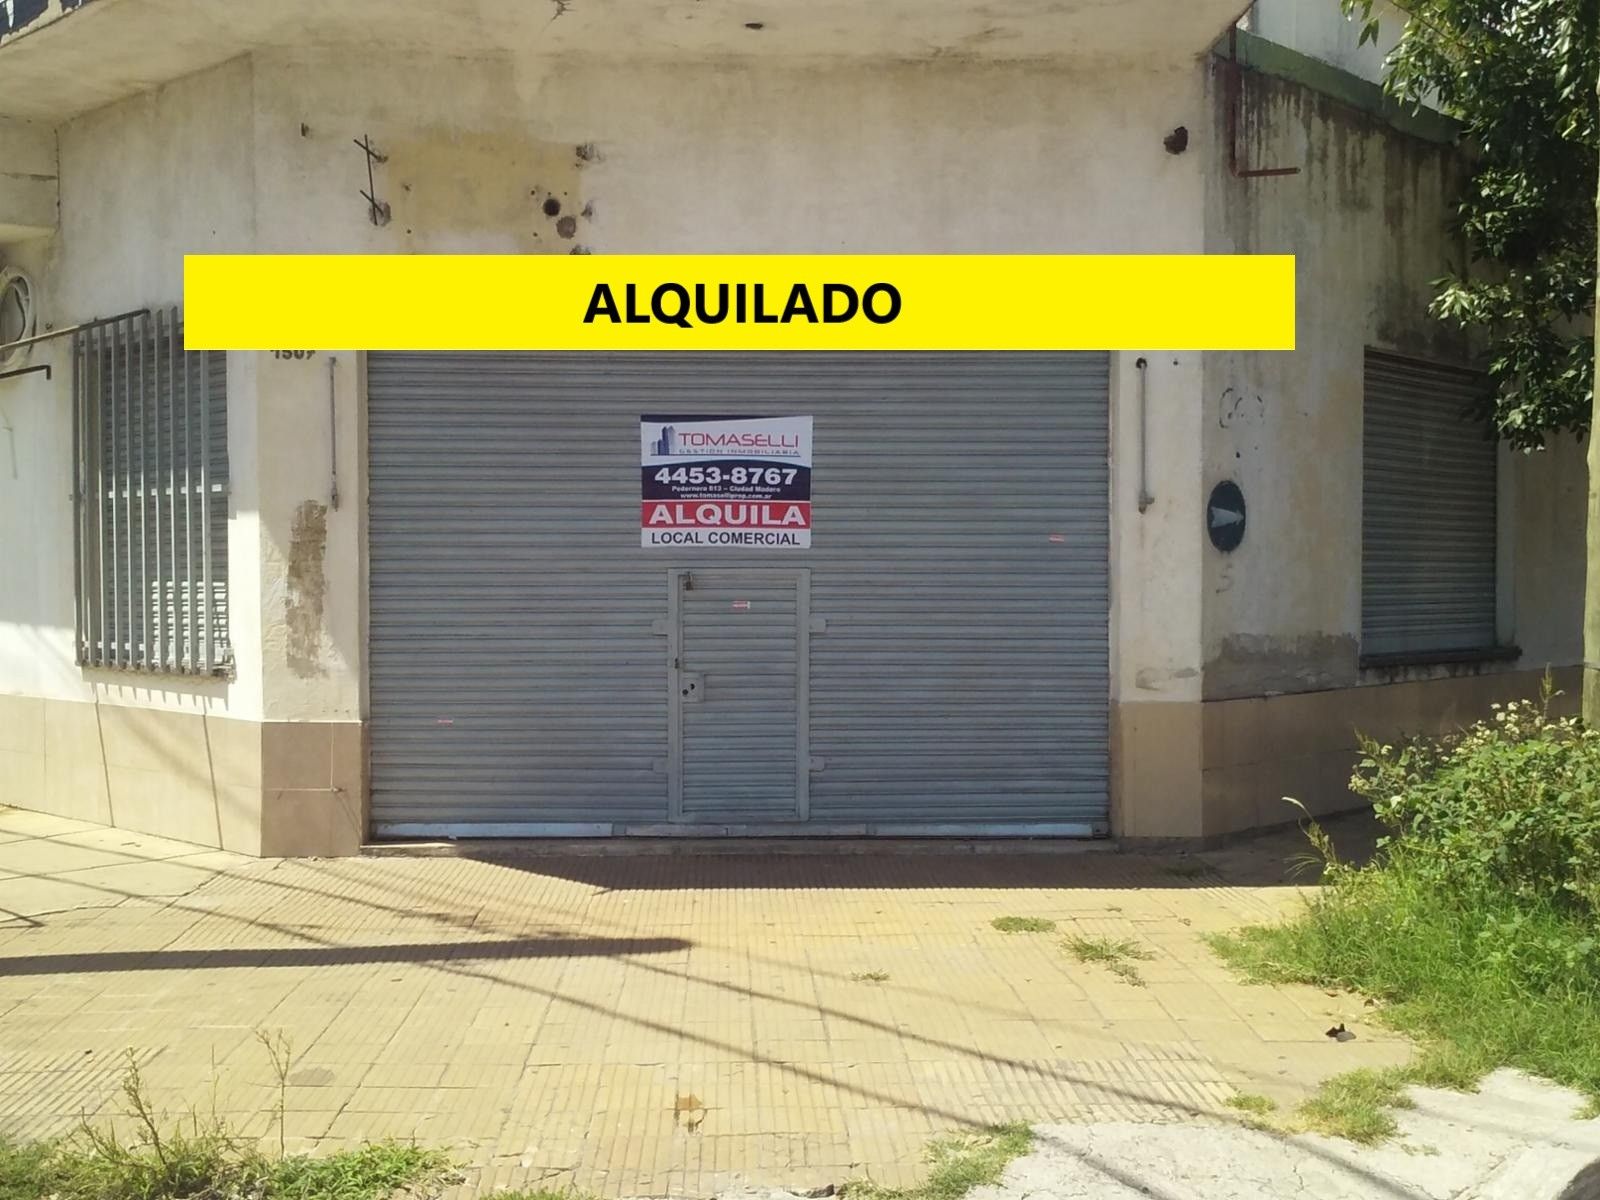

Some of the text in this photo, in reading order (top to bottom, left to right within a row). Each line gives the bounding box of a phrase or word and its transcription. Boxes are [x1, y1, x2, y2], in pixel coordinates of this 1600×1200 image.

[679, 433, 798, 448] TOMASELLI
[654, 467, 798, 485] 4453-8767
[755, 486, 781, 494] Madero
[649, 504, 806, 526] ALQUILA
[652, 532, 800, 546] LOCAL COMERCIAL
